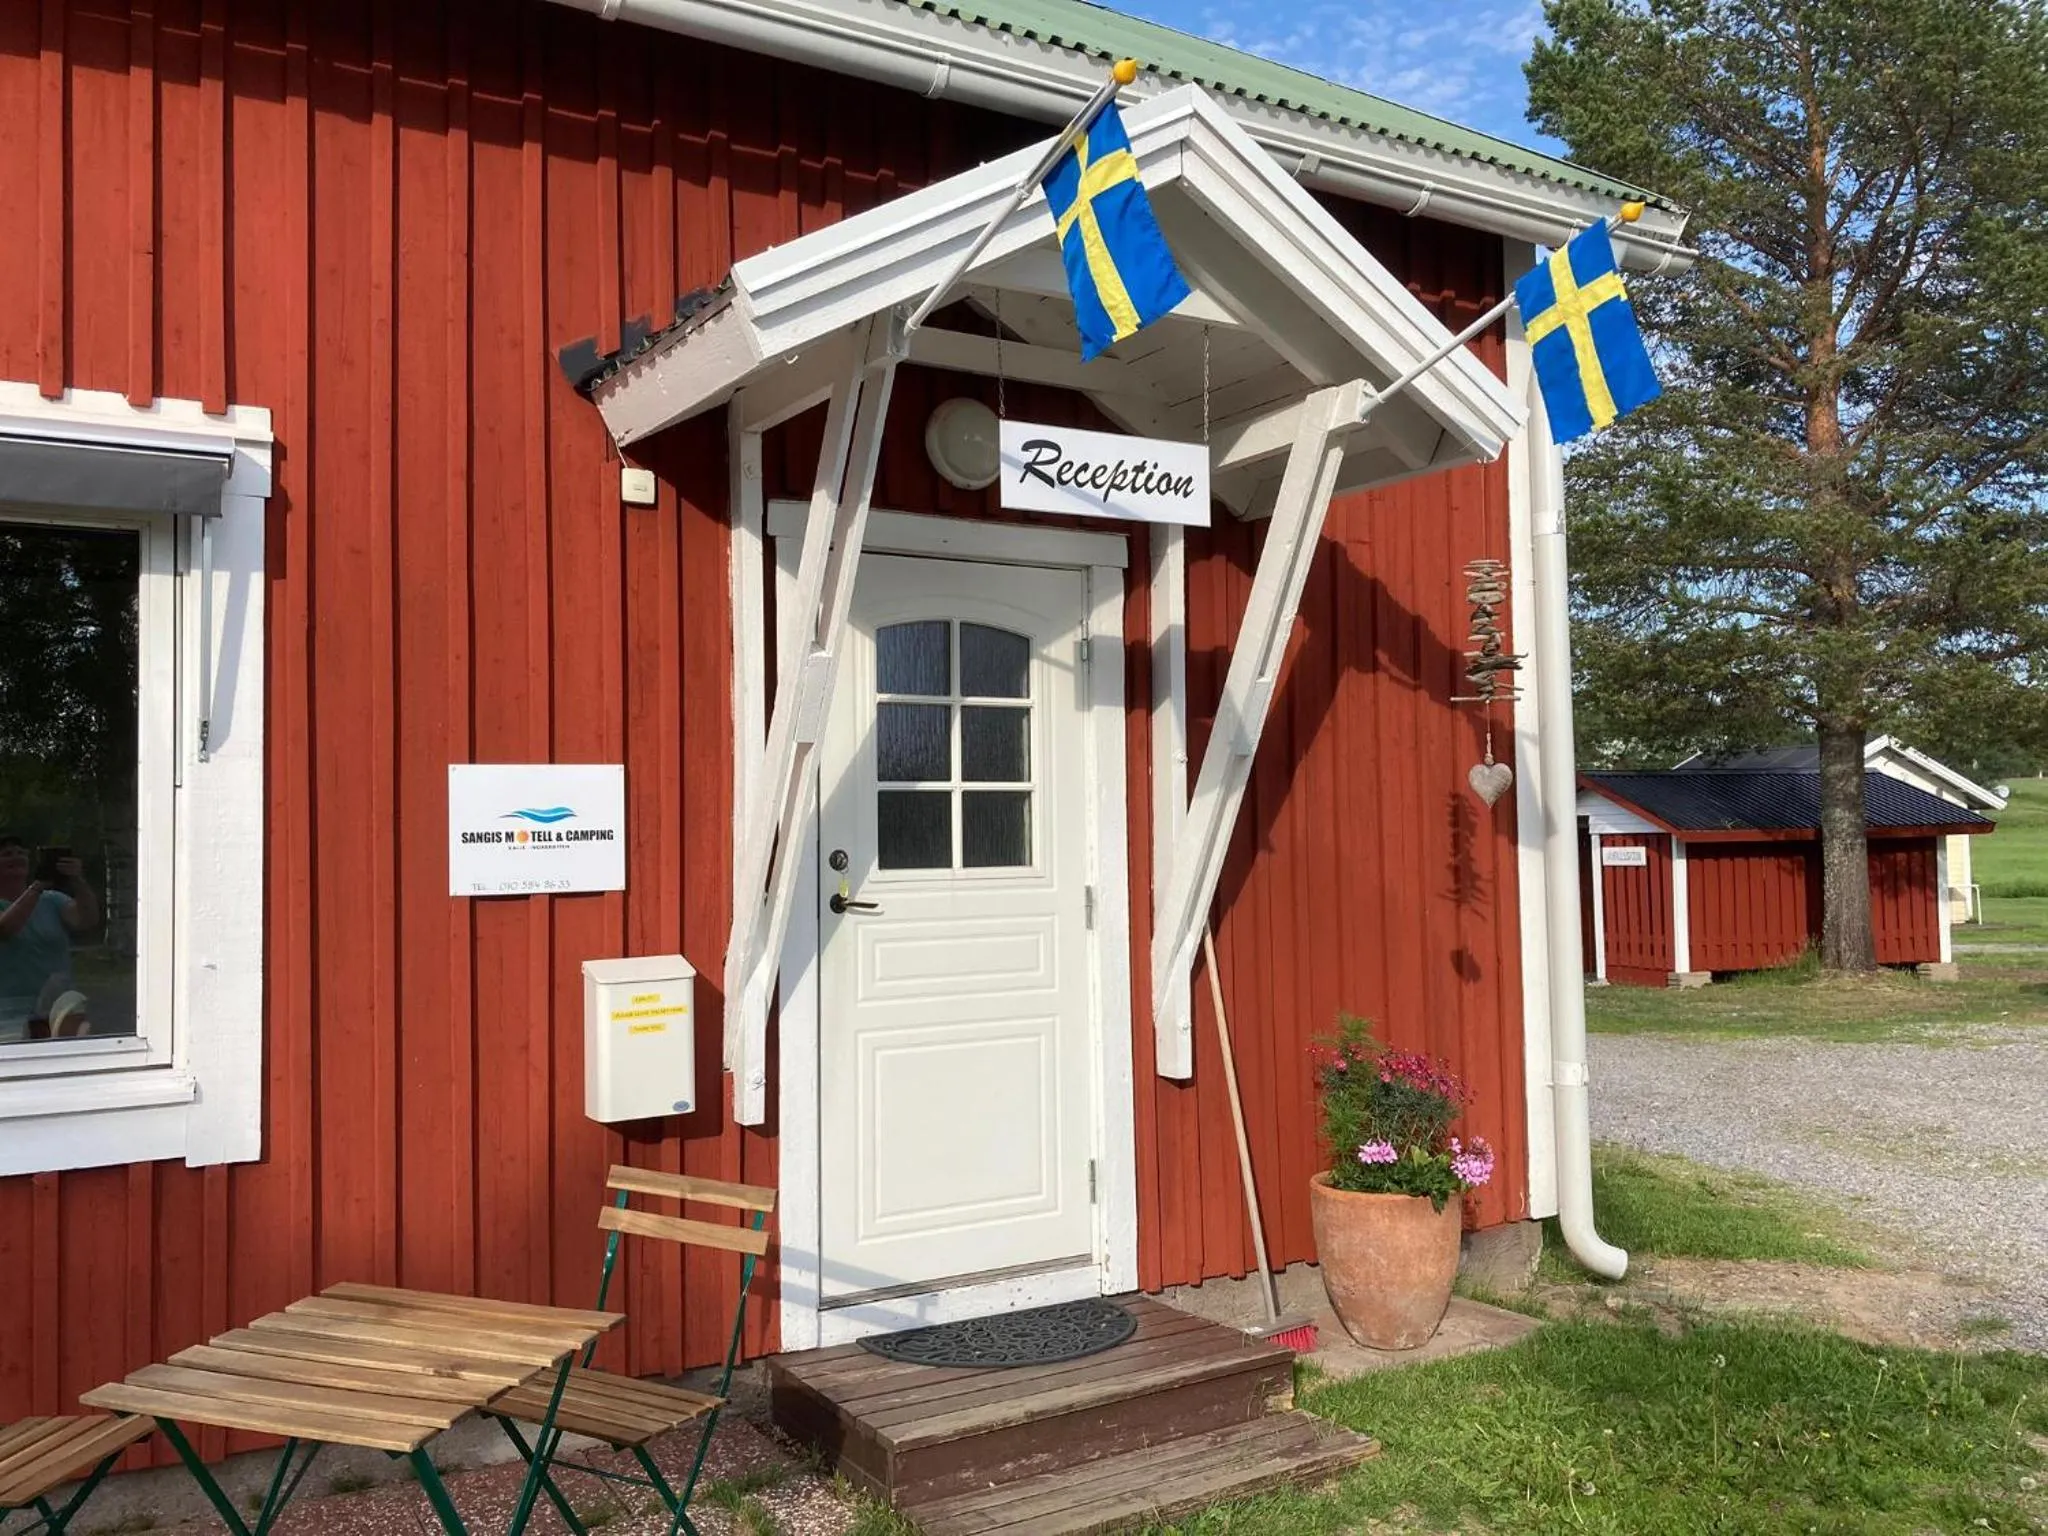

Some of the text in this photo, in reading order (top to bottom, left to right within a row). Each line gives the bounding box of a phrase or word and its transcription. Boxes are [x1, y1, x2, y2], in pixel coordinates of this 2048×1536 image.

[1019, 438, 1195, 503] Reception
[461, 831, 502, 844] SANGIS
[555, 832, 563, 841] &
[565, 829, 614, 842] CAMPING
